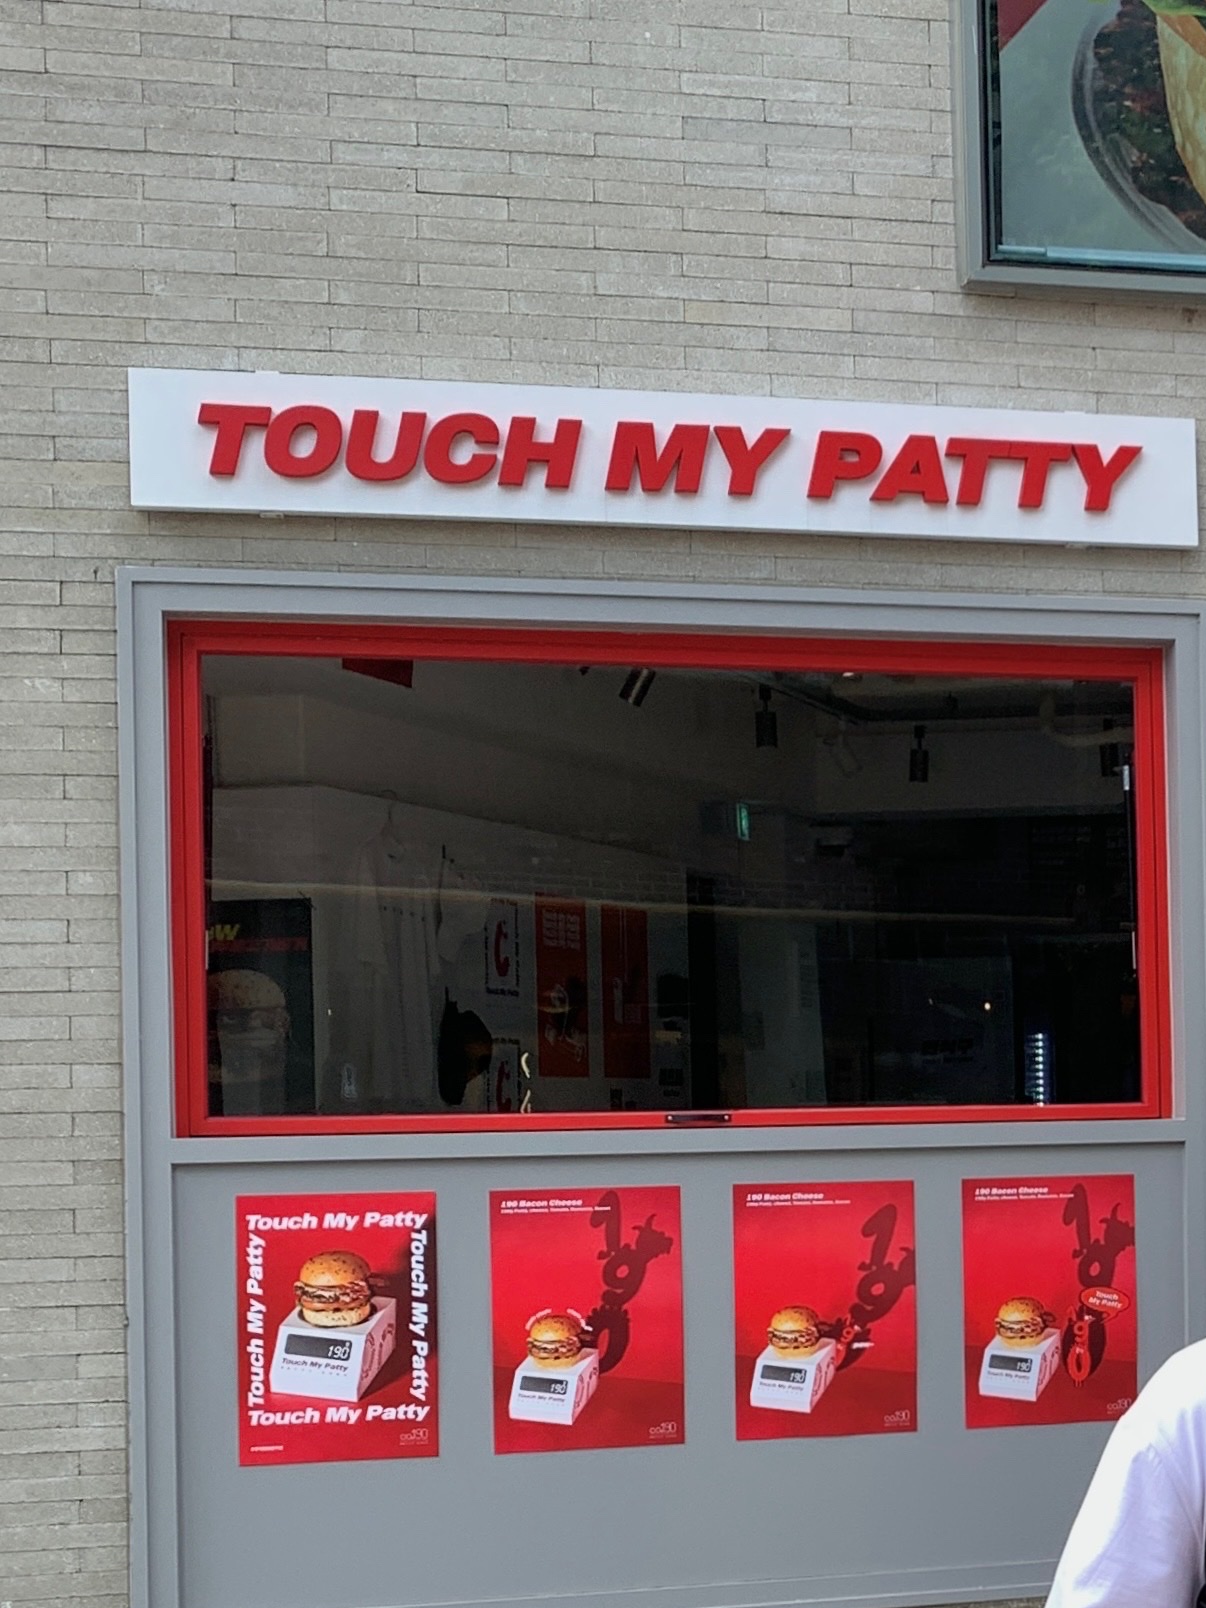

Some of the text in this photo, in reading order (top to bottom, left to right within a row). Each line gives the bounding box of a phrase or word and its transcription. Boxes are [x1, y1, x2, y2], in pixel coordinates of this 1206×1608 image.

[197, 402, 1144, 511] TOUCH MY PATTY
[246, 1210, 428, 1231] Touch My Patty
[1095, 1290, 1119, 1300] Touch
[246, 1232, 266, 1407] Touch My Patty
[408, 1229, 429, 1401] Touch My Patty
[282, 1358, 308, 1367] Touch
[309, 1361, 322, 1369] My
[324, 1363, 349, 1372] Patty
[248, 1402, 430, 1427] Touch My Patty
